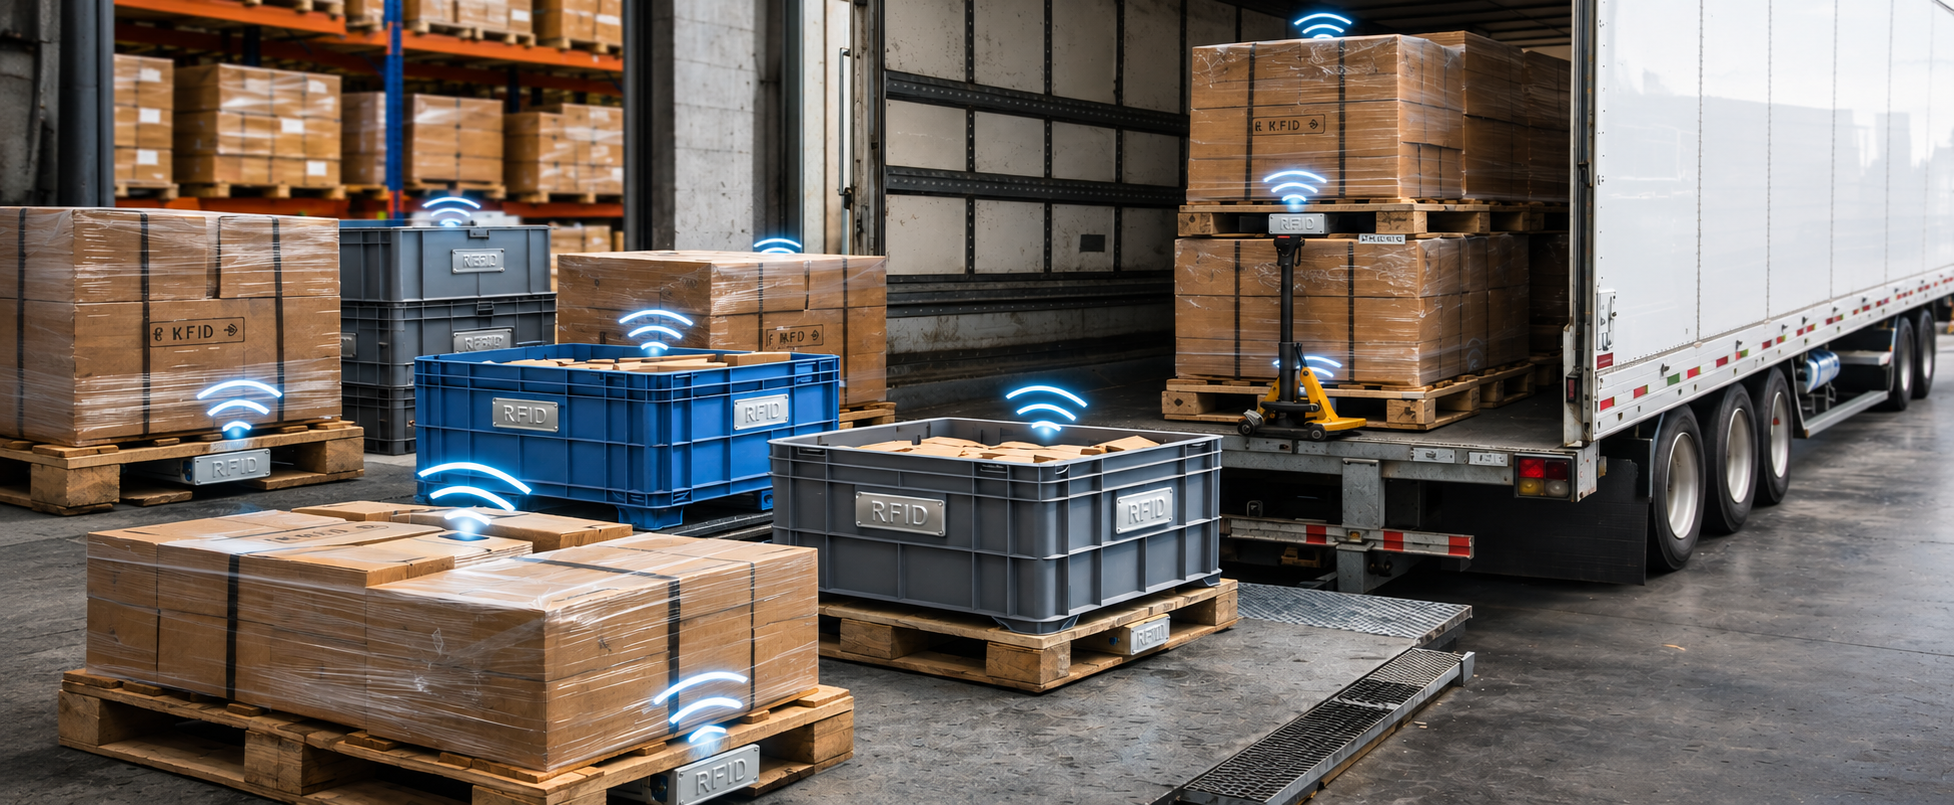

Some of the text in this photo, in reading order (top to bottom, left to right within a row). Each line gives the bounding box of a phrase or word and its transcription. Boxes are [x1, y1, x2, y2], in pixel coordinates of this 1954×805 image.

[172, 324, 214, 341] KFID
[503, 404, 548, 424] RFID
[745, 402, 780, 423] RFID
[212, 457, 257, 478] RFID
[871, 500, 928, 525] RFID
[1128, 496, 1165, 525] RFID
[695, 758, 747, 796] RFID
